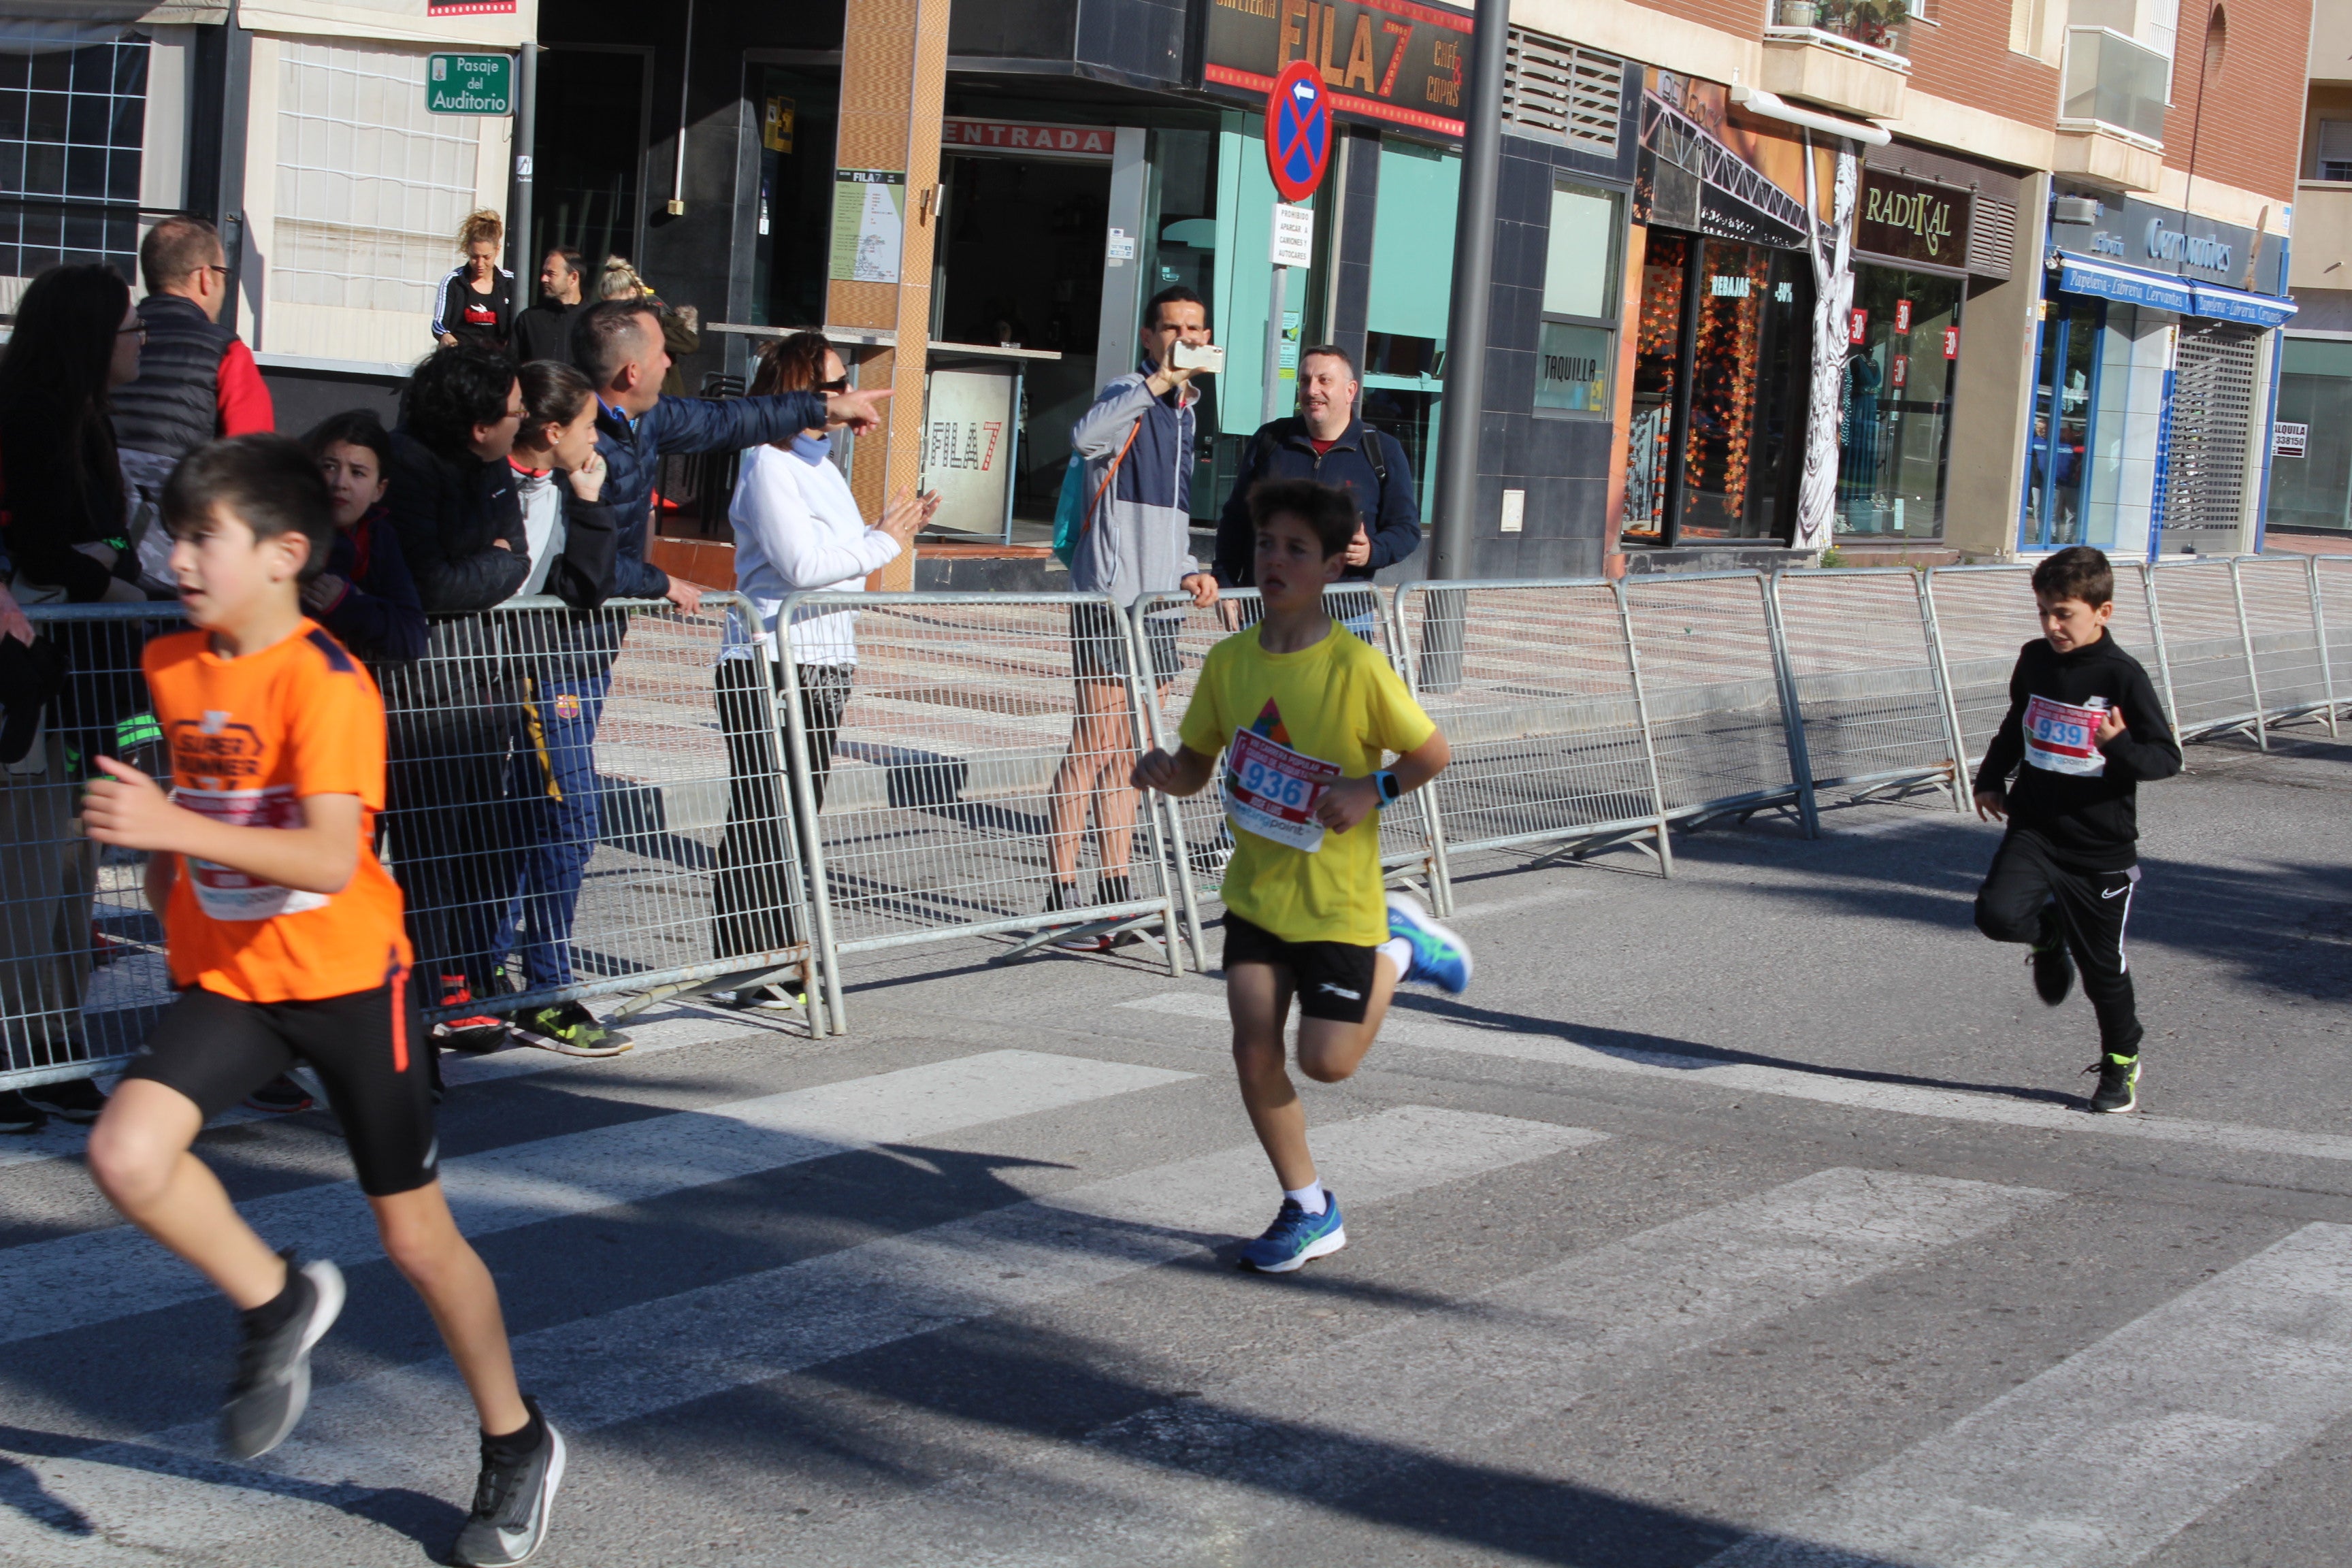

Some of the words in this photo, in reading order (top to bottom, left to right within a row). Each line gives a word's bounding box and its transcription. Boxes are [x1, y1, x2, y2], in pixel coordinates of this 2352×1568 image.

[457, 57, 499, 76] Pasaje
[467, 77, 483, 89] del
[1426, 75, 1460, 107] COPAS
[432, 90, 506, 111] Auditorio
[943, 123, 1103, 151] ENTRADA
[1865, 187, 1952, 256] RADIKAL
[1711, 275, 1751, 298] REBAJAS
[1545, 355, 1596, 382] TAQUILLA
[2039, 719, 2082, 745] 939
[1245, 763, 1304, 806] 936
